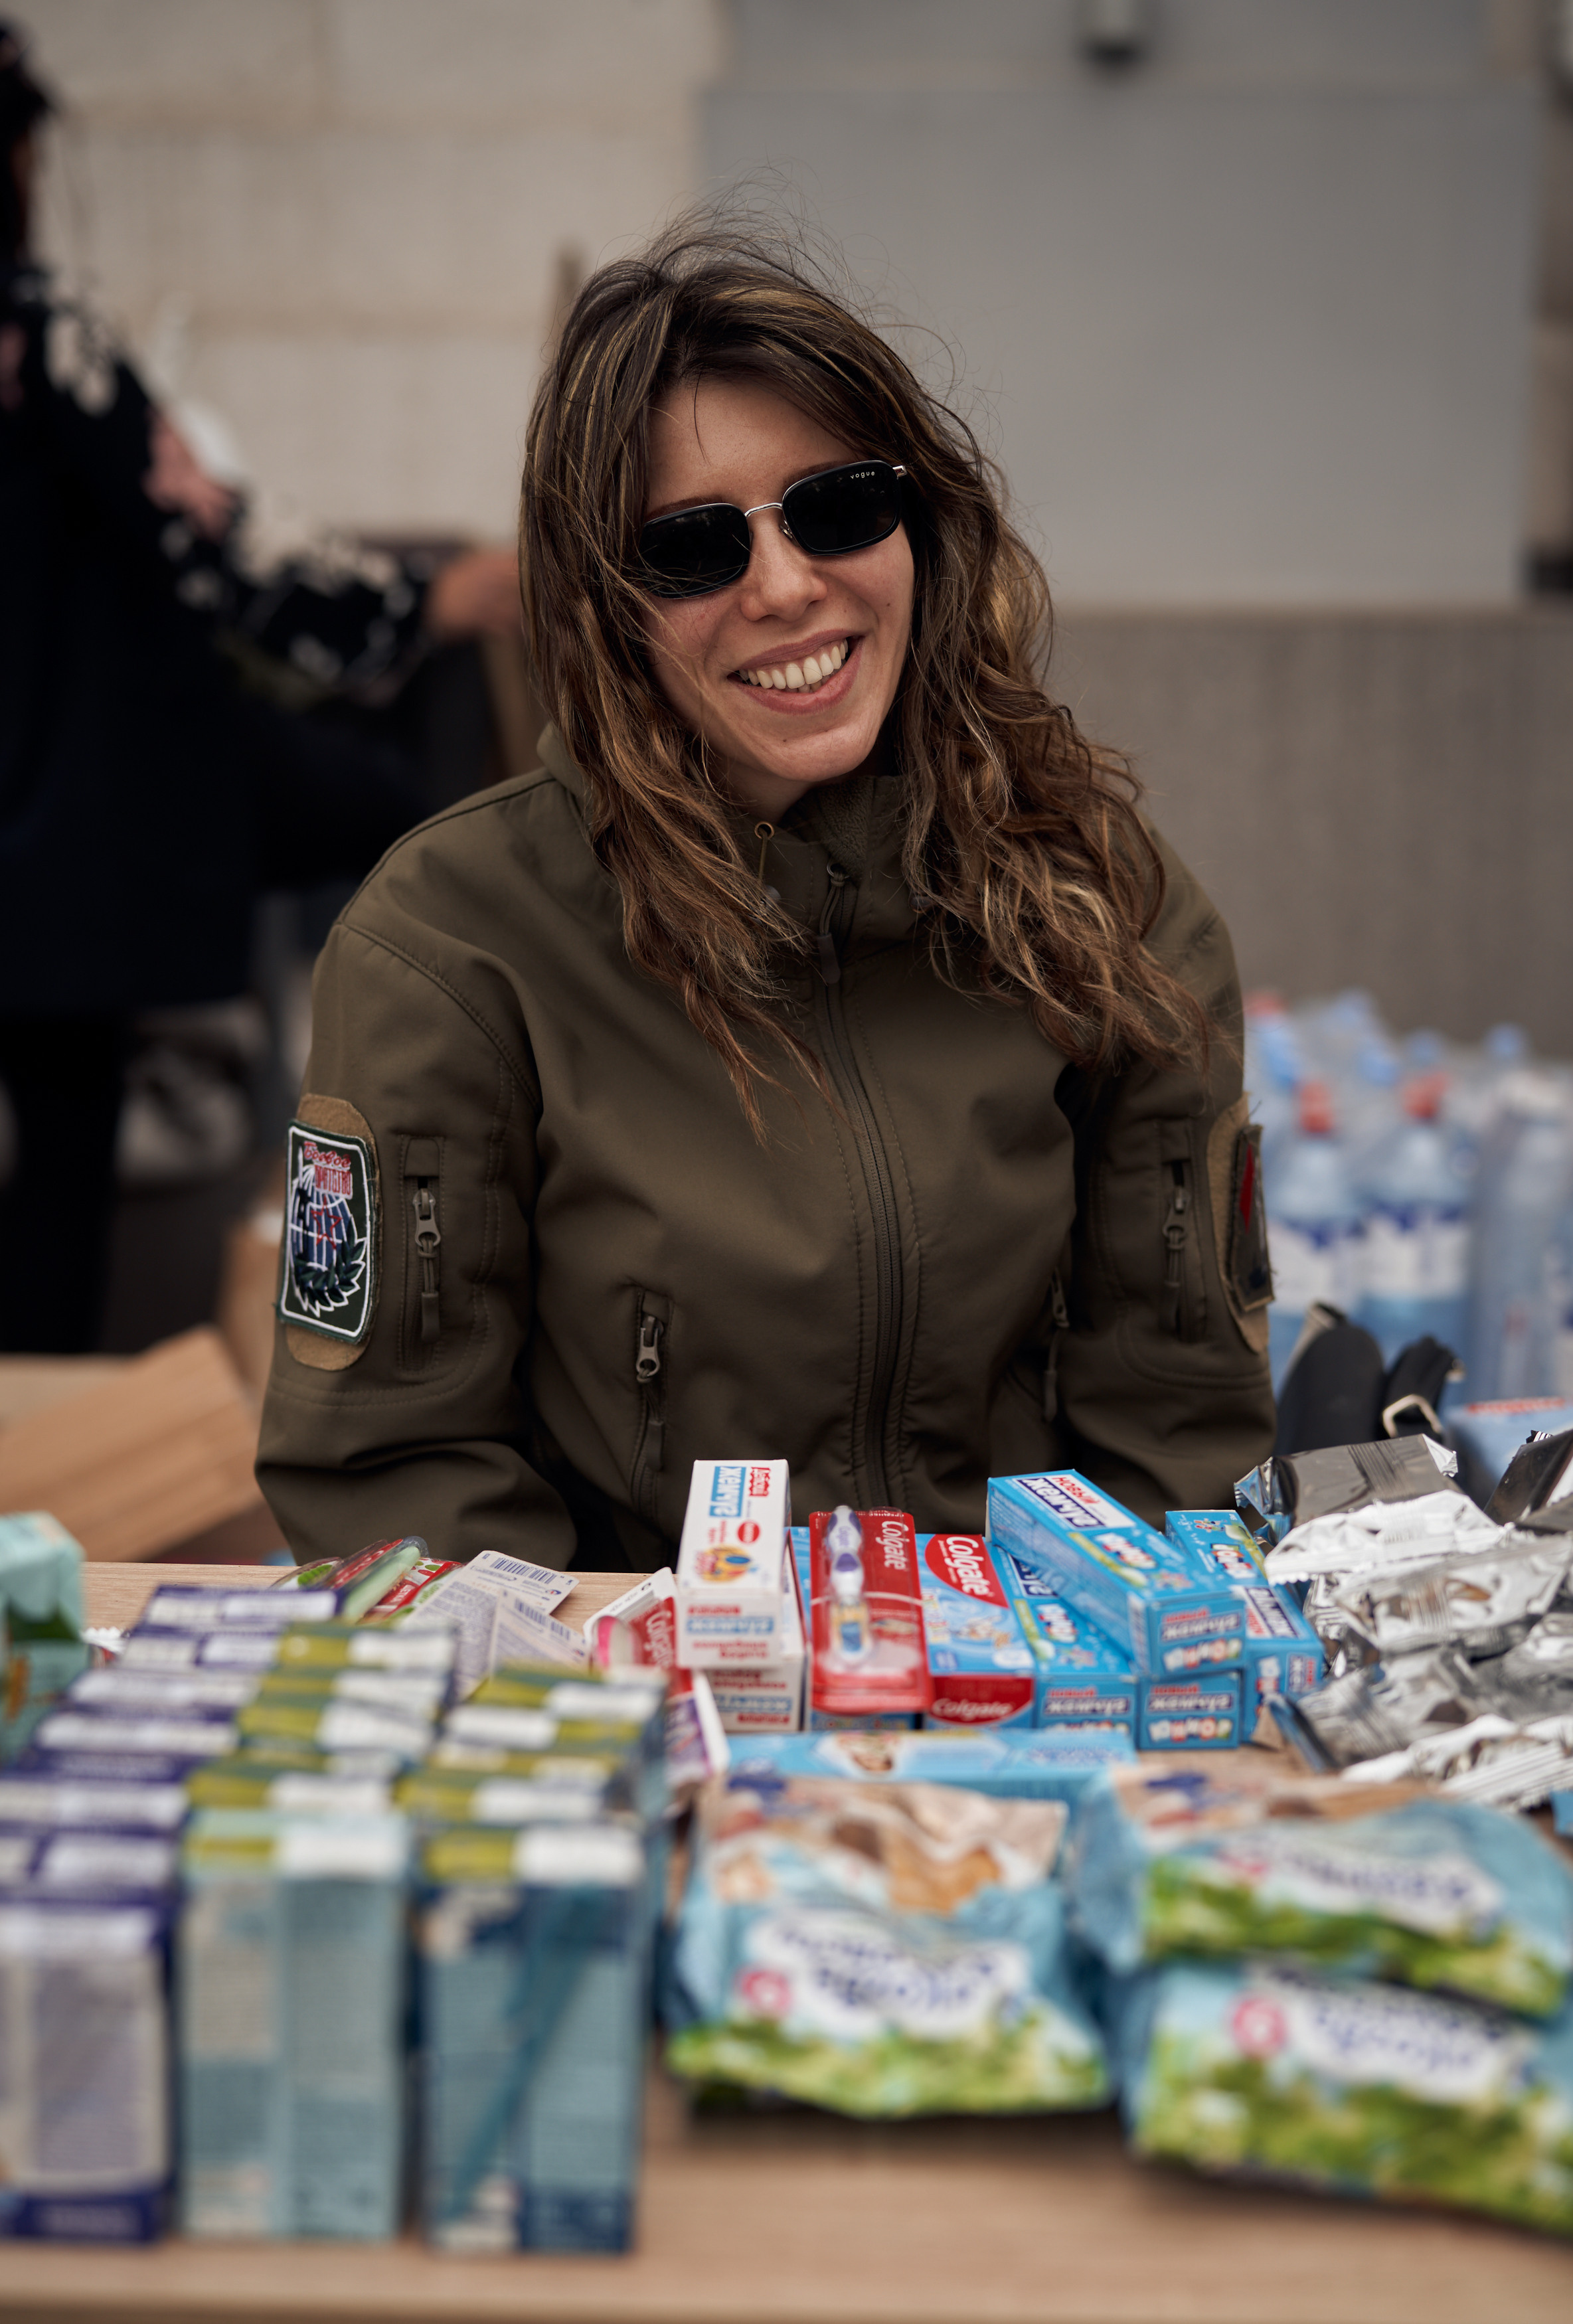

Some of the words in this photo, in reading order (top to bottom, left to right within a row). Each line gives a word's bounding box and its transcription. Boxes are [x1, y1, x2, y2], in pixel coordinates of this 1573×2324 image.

[850, 470, 875, 479] vogue
[875, 1521, 910, 1570] Colgate
[944, 1536, 991, 1595] Colgate
[932, 1698, 1012, 1720] Colgate
